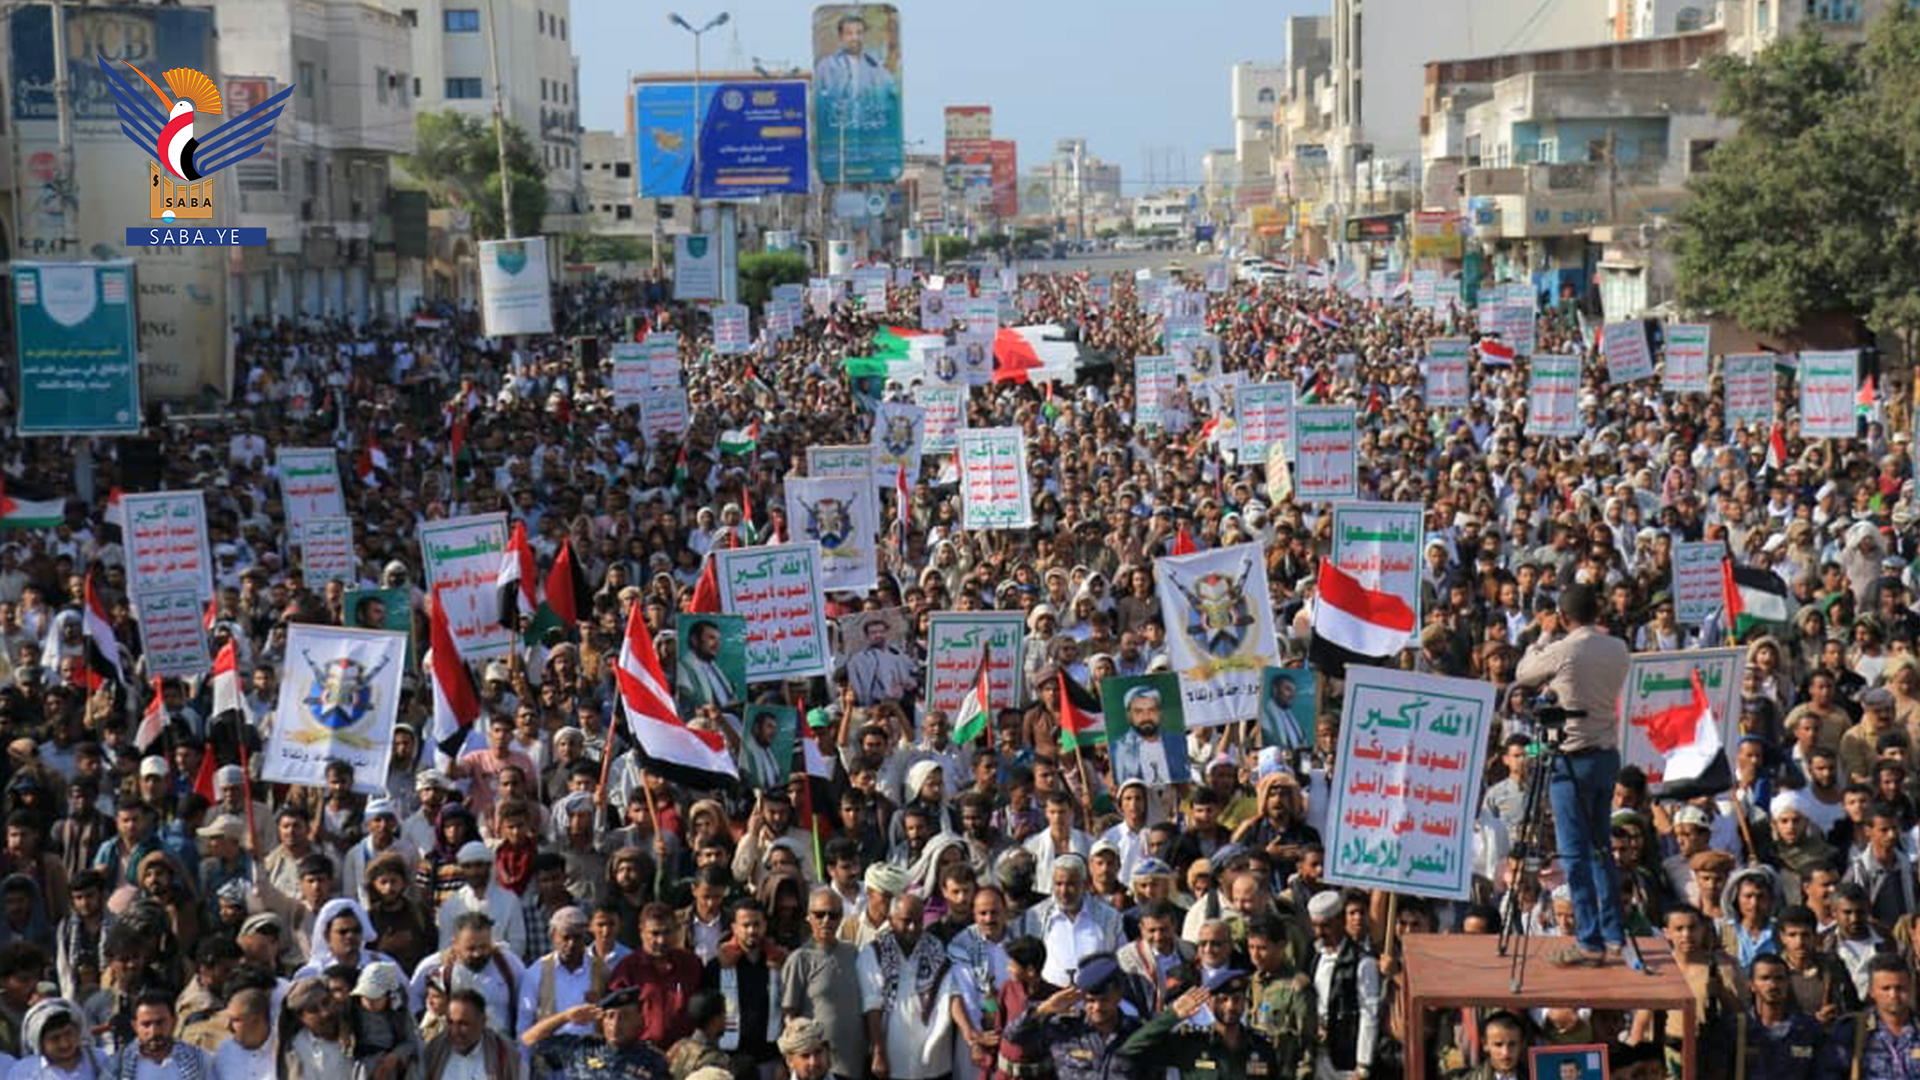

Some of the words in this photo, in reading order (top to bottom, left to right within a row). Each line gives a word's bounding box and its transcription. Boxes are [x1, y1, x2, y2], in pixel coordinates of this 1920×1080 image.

[1340, 519, 1416, 547] قاطعوا
[780, 554, 808, 575] الله
[987, 625, 1016, 648] الله
[1429, 705, 1473, 738] الله
[1417, 750, 1467, 773] الموت
[1413, 782, 1462, 806] الموت
[1345, 807, 1389, 832] اليهود
[1393, 807, 1415, 836] على
[1421, 812, 1459, 839] اللعنة
[1405, 841, 1457, 877] النصر
